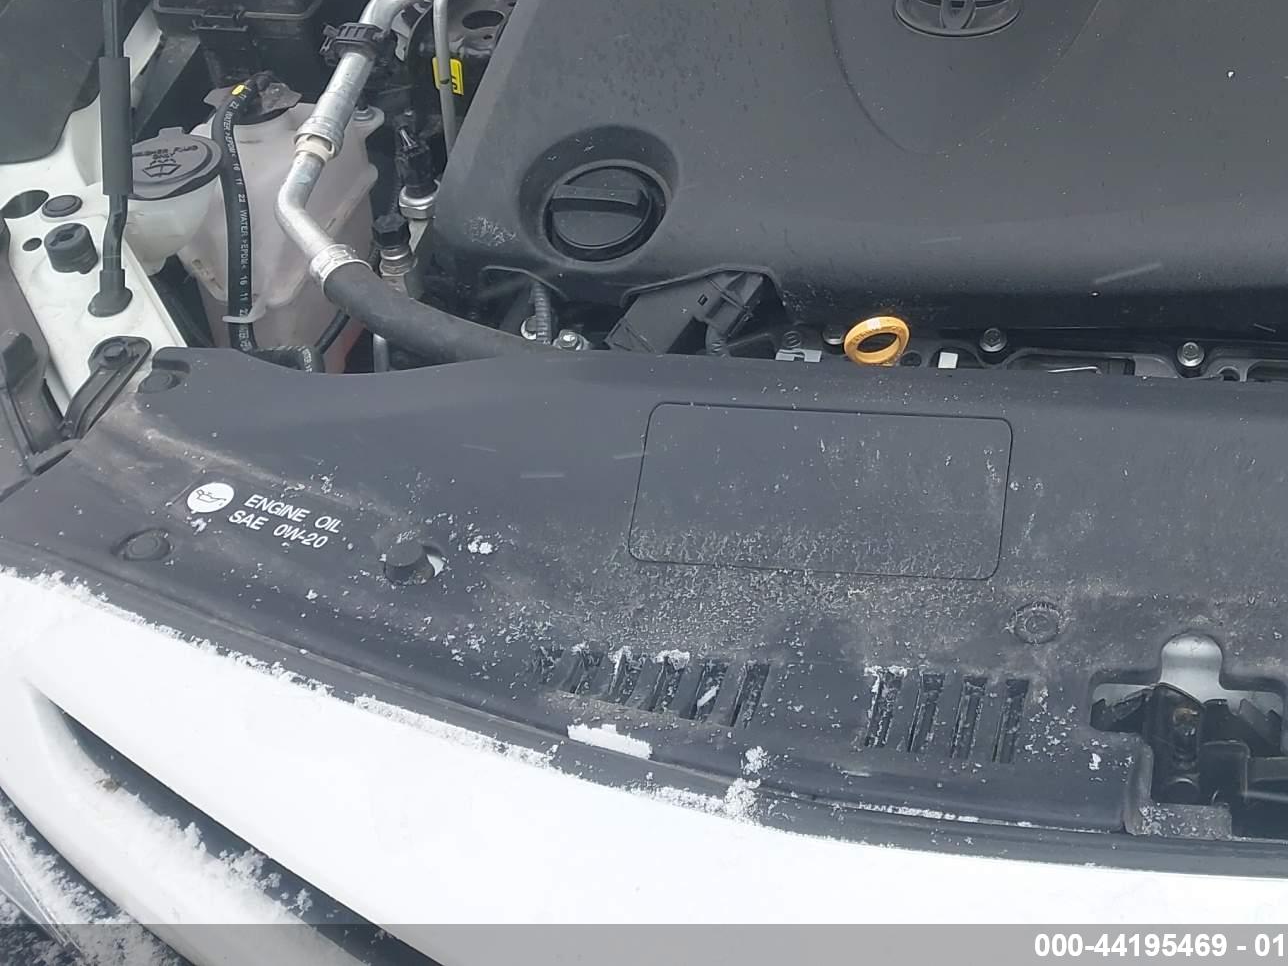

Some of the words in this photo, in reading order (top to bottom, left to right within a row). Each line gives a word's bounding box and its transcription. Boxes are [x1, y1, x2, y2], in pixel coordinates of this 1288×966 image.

[238, 194, 246, 203] 22
[240, 210, 249, 237] WATER
[239, 276, 248, 285] 16
[243, 494, 310, 522] ENGINE
[314, 516, 343, 534] OIL
[228, 510, 269, 531] SAE
[273, 524, 329, 547] 0W-20
